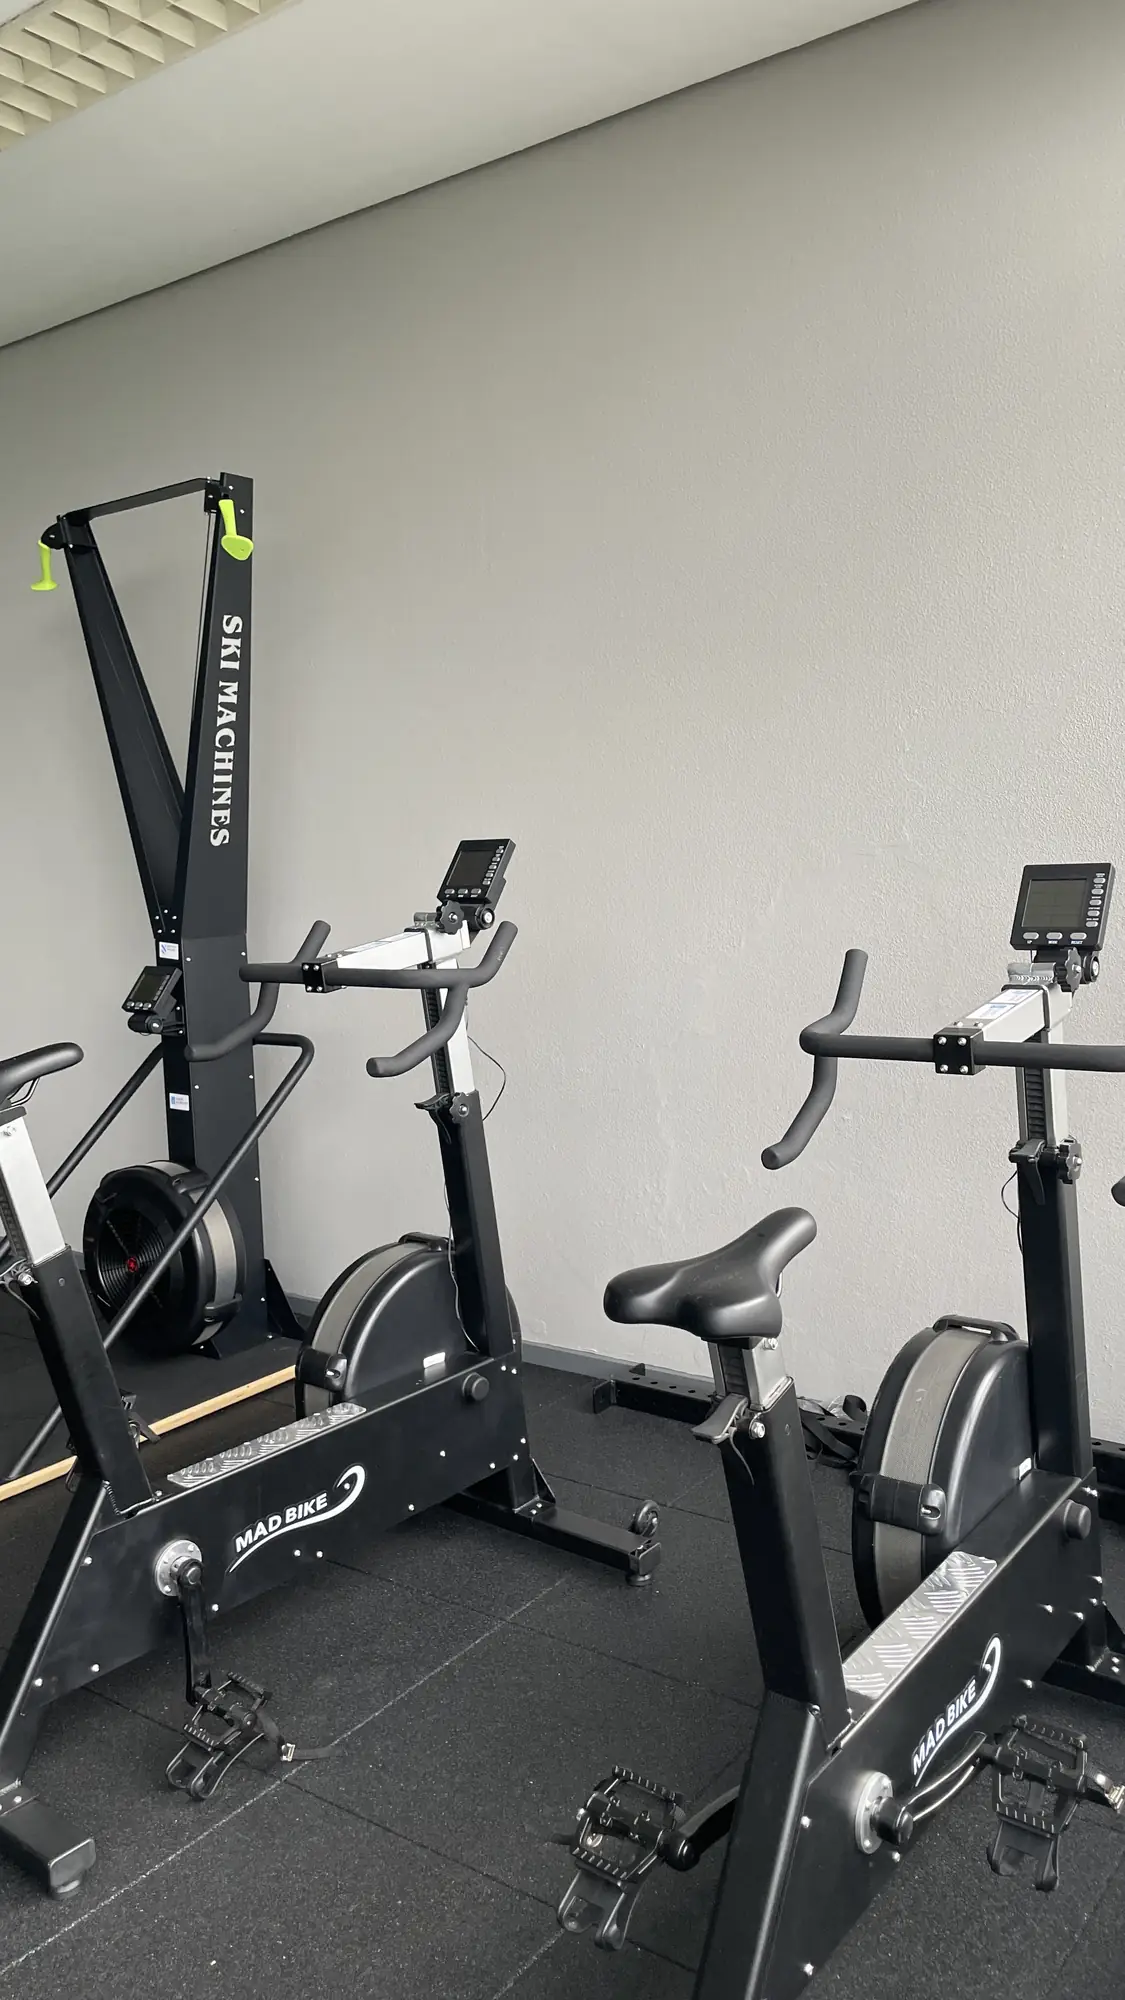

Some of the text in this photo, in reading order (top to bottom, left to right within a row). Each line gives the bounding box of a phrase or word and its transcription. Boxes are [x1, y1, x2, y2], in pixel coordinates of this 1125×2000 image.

[209, 614, 244, 847] SKI MACHINES
[235, 1492, 328, 1553] MAD BIKE
[913, 1679, 976, 1776] MAD BIKE
